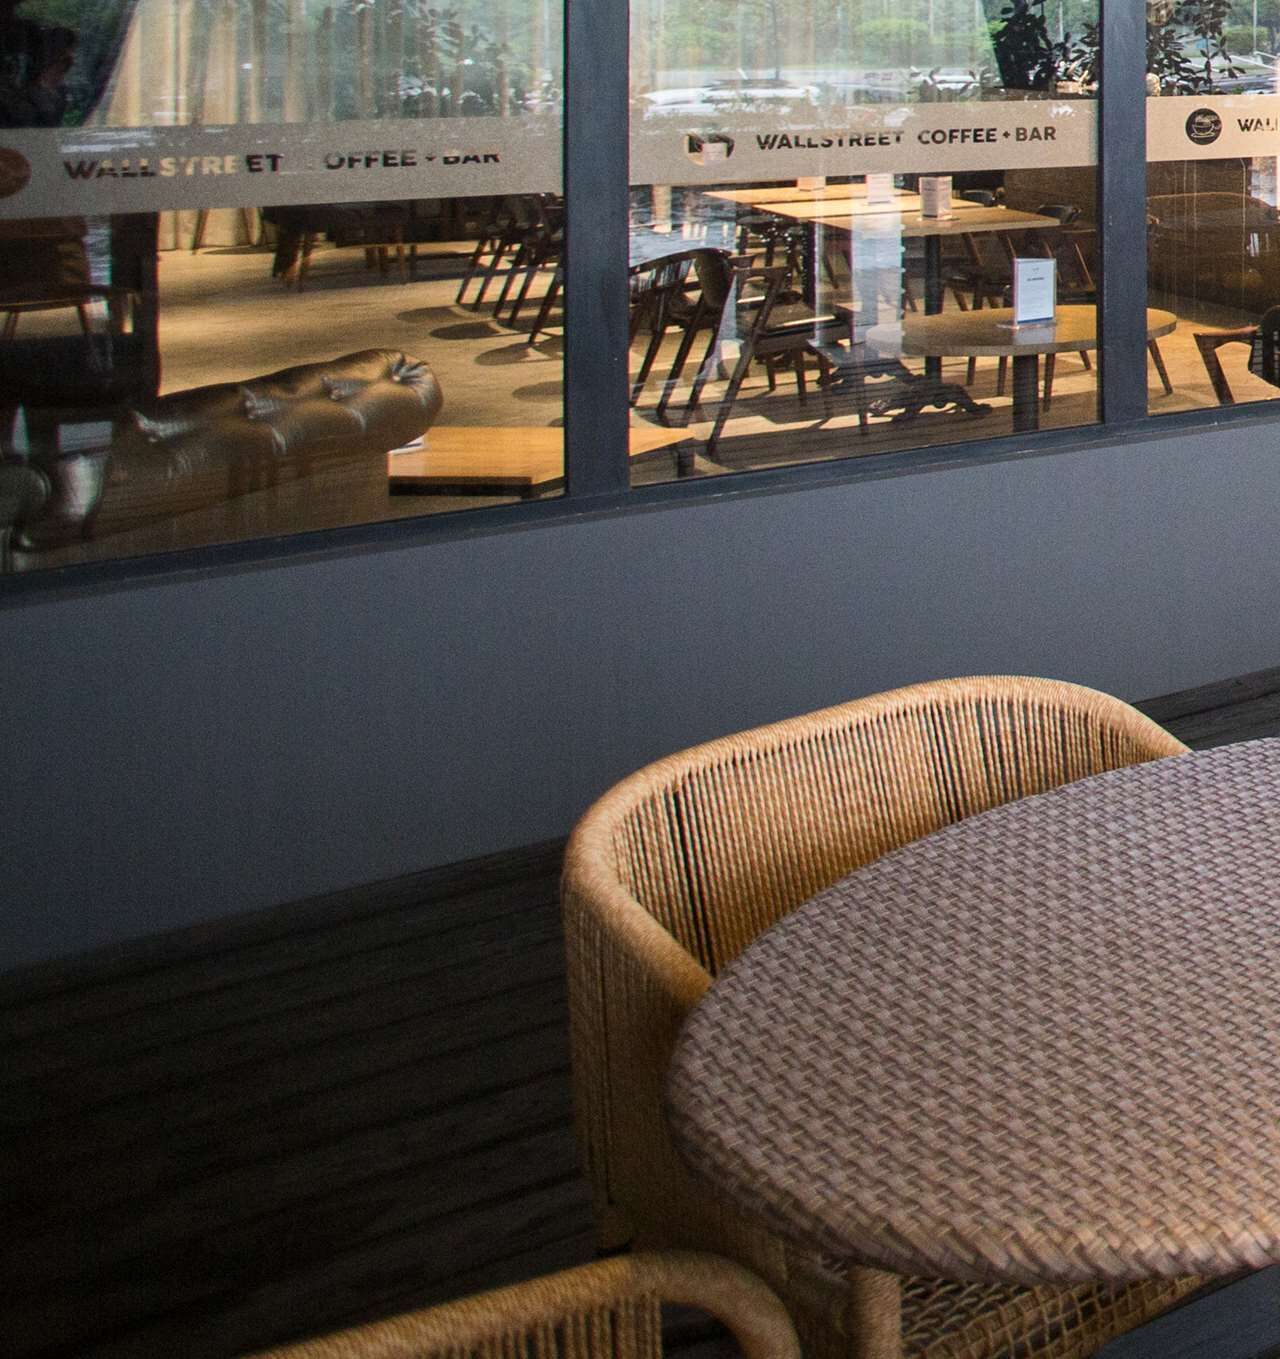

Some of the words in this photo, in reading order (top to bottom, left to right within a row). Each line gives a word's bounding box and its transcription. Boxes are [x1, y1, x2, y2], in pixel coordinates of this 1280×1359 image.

[917, 127, 998, 145] COFFEE
[1015, 126, 1057, 142] BAR
[322, 150, 418, 171] OFFEE
